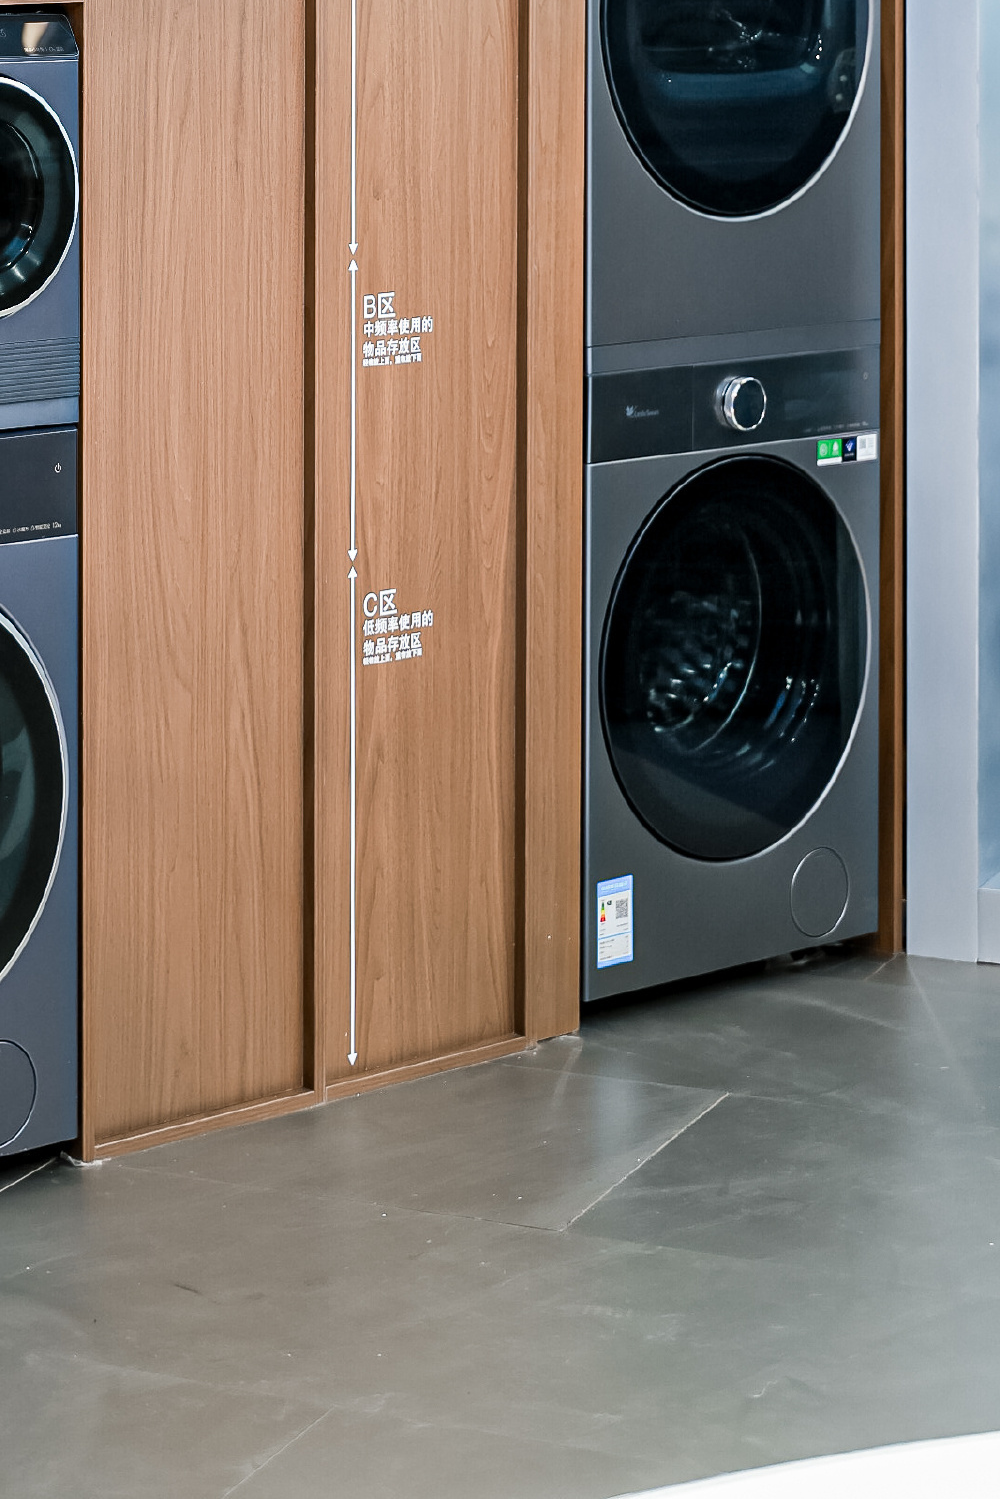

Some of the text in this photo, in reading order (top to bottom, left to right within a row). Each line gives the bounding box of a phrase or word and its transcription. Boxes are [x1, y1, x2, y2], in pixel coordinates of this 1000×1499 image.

[363, 291, 396, 319] B区
[363, 315, 433, 337] 中频率使用的
[363, 336, 421, 358] 物品存放区
[363, 588, 398, 618] C区
[363, 609, 434, 637] 低频率使用的
[363, 631, 422, 657] 物品存放区
